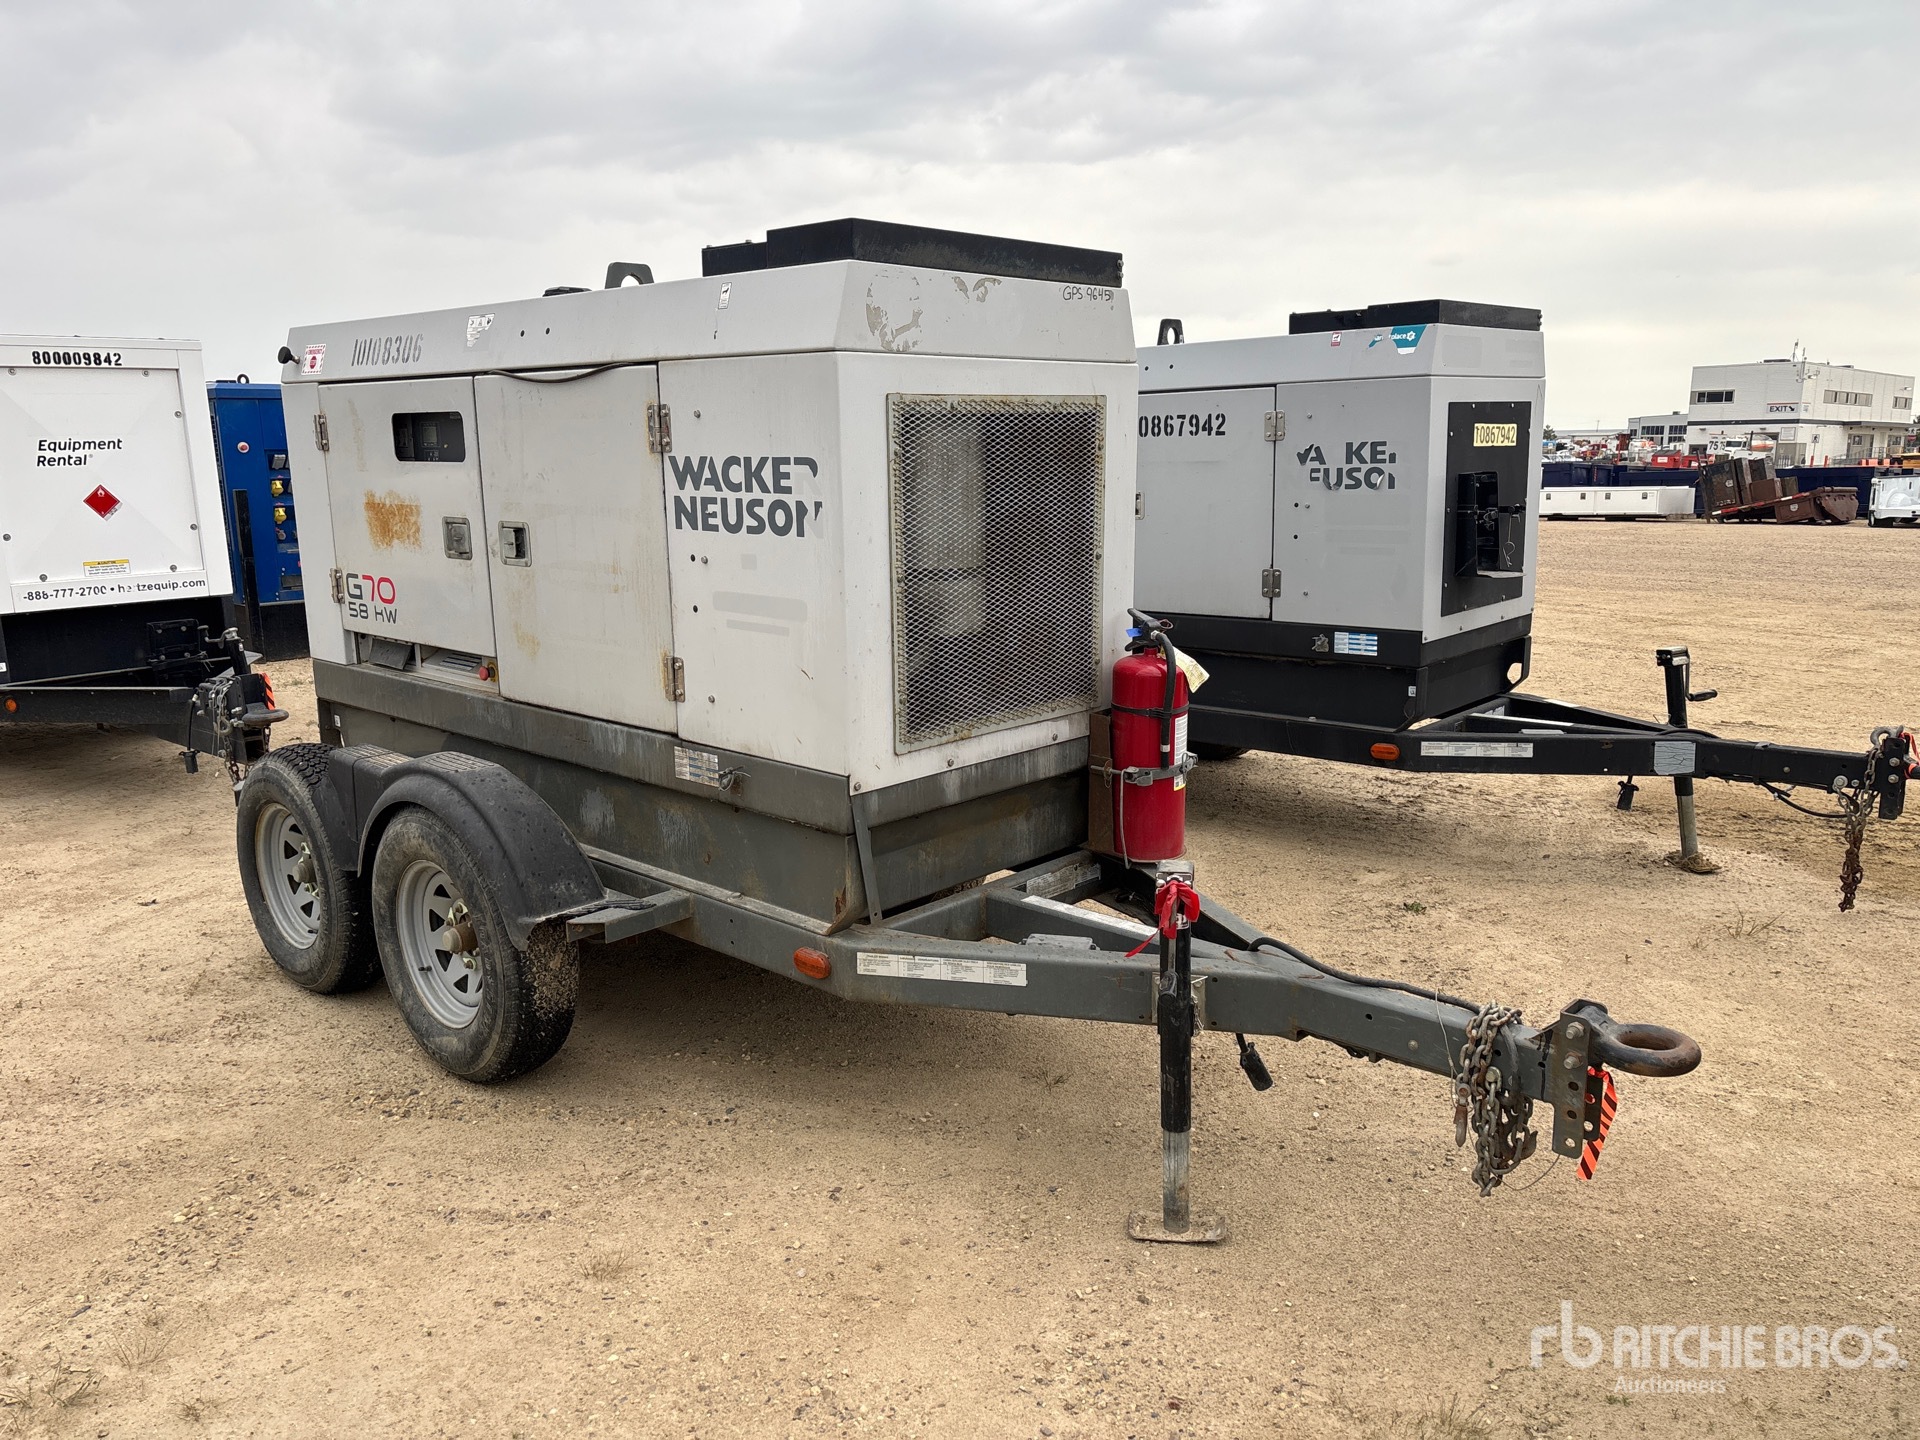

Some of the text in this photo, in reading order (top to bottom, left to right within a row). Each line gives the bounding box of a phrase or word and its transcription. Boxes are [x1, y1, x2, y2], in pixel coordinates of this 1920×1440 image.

[1063, 285, 1083, 301] GPS
[32, 350, 122, 366] 800009842
[1769, 405, 1788, 413] EXIT
[38, 437, 123, 453] Equipment
[346, 573, 396, 605] G70
[348, 601, 369, 619] 58
